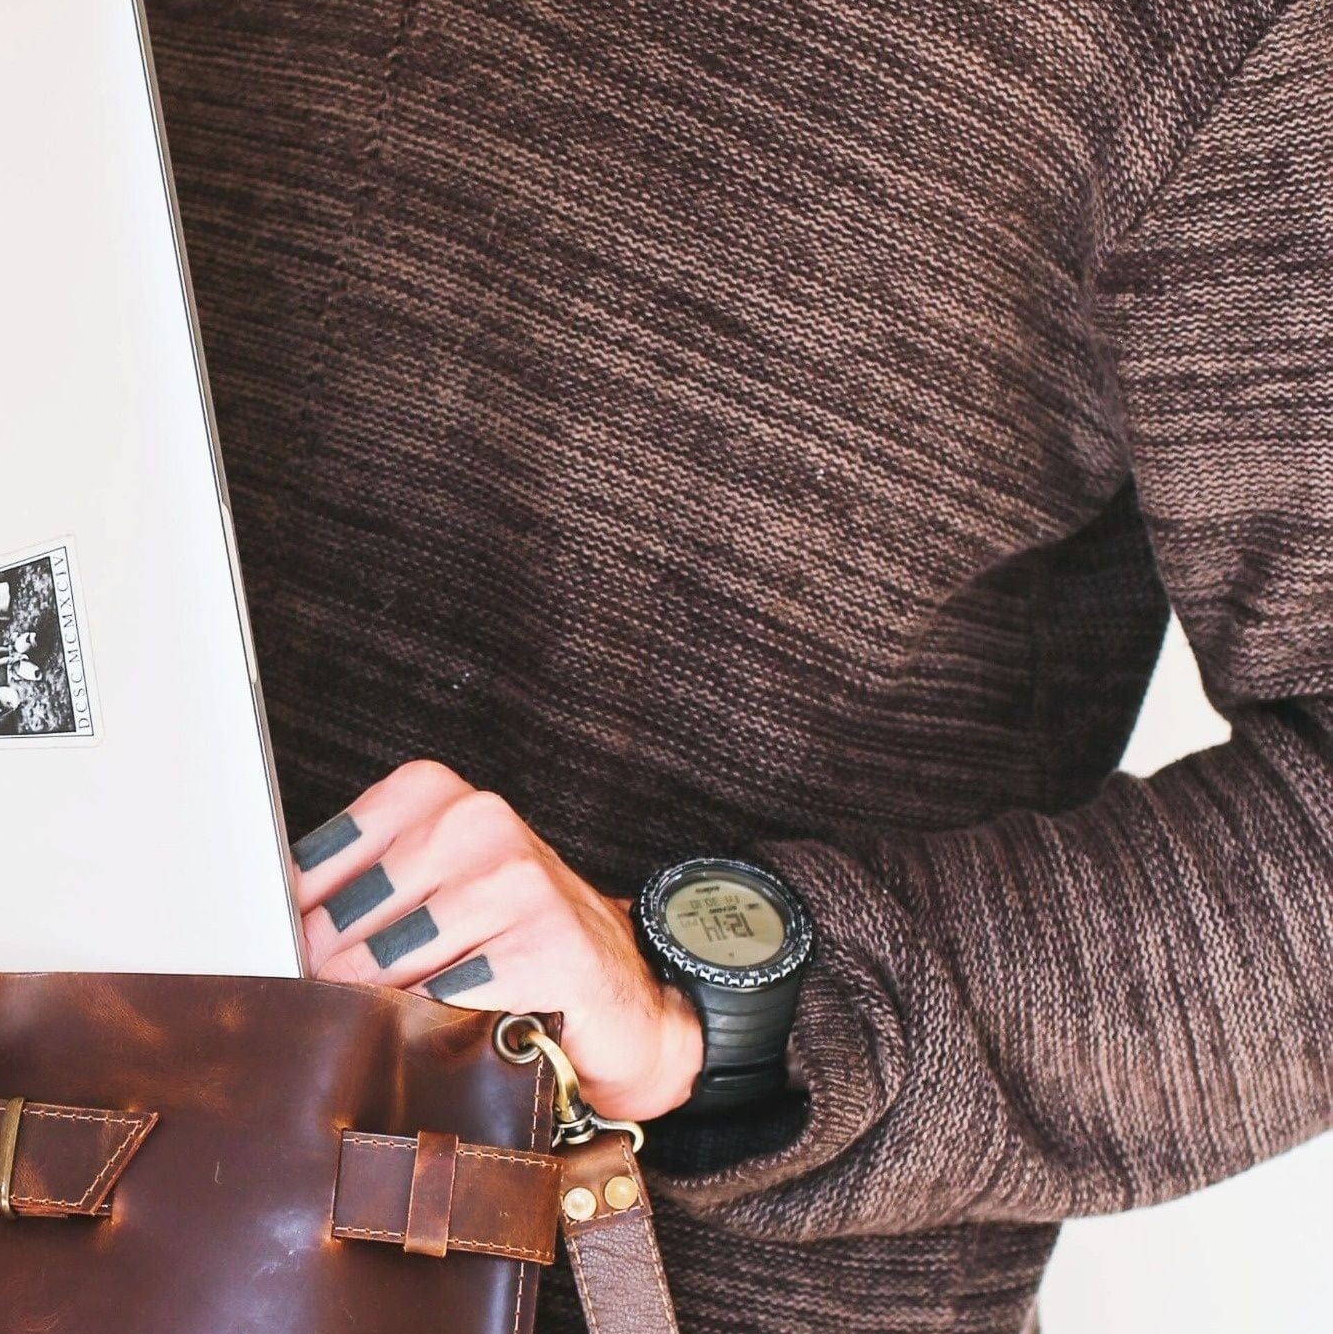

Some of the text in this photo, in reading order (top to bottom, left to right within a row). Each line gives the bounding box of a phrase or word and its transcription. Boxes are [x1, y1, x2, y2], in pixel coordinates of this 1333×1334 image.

[53, 556, 90, 730] DCSC MCMXCIV
[700, 912, 755, 942] 12:14
